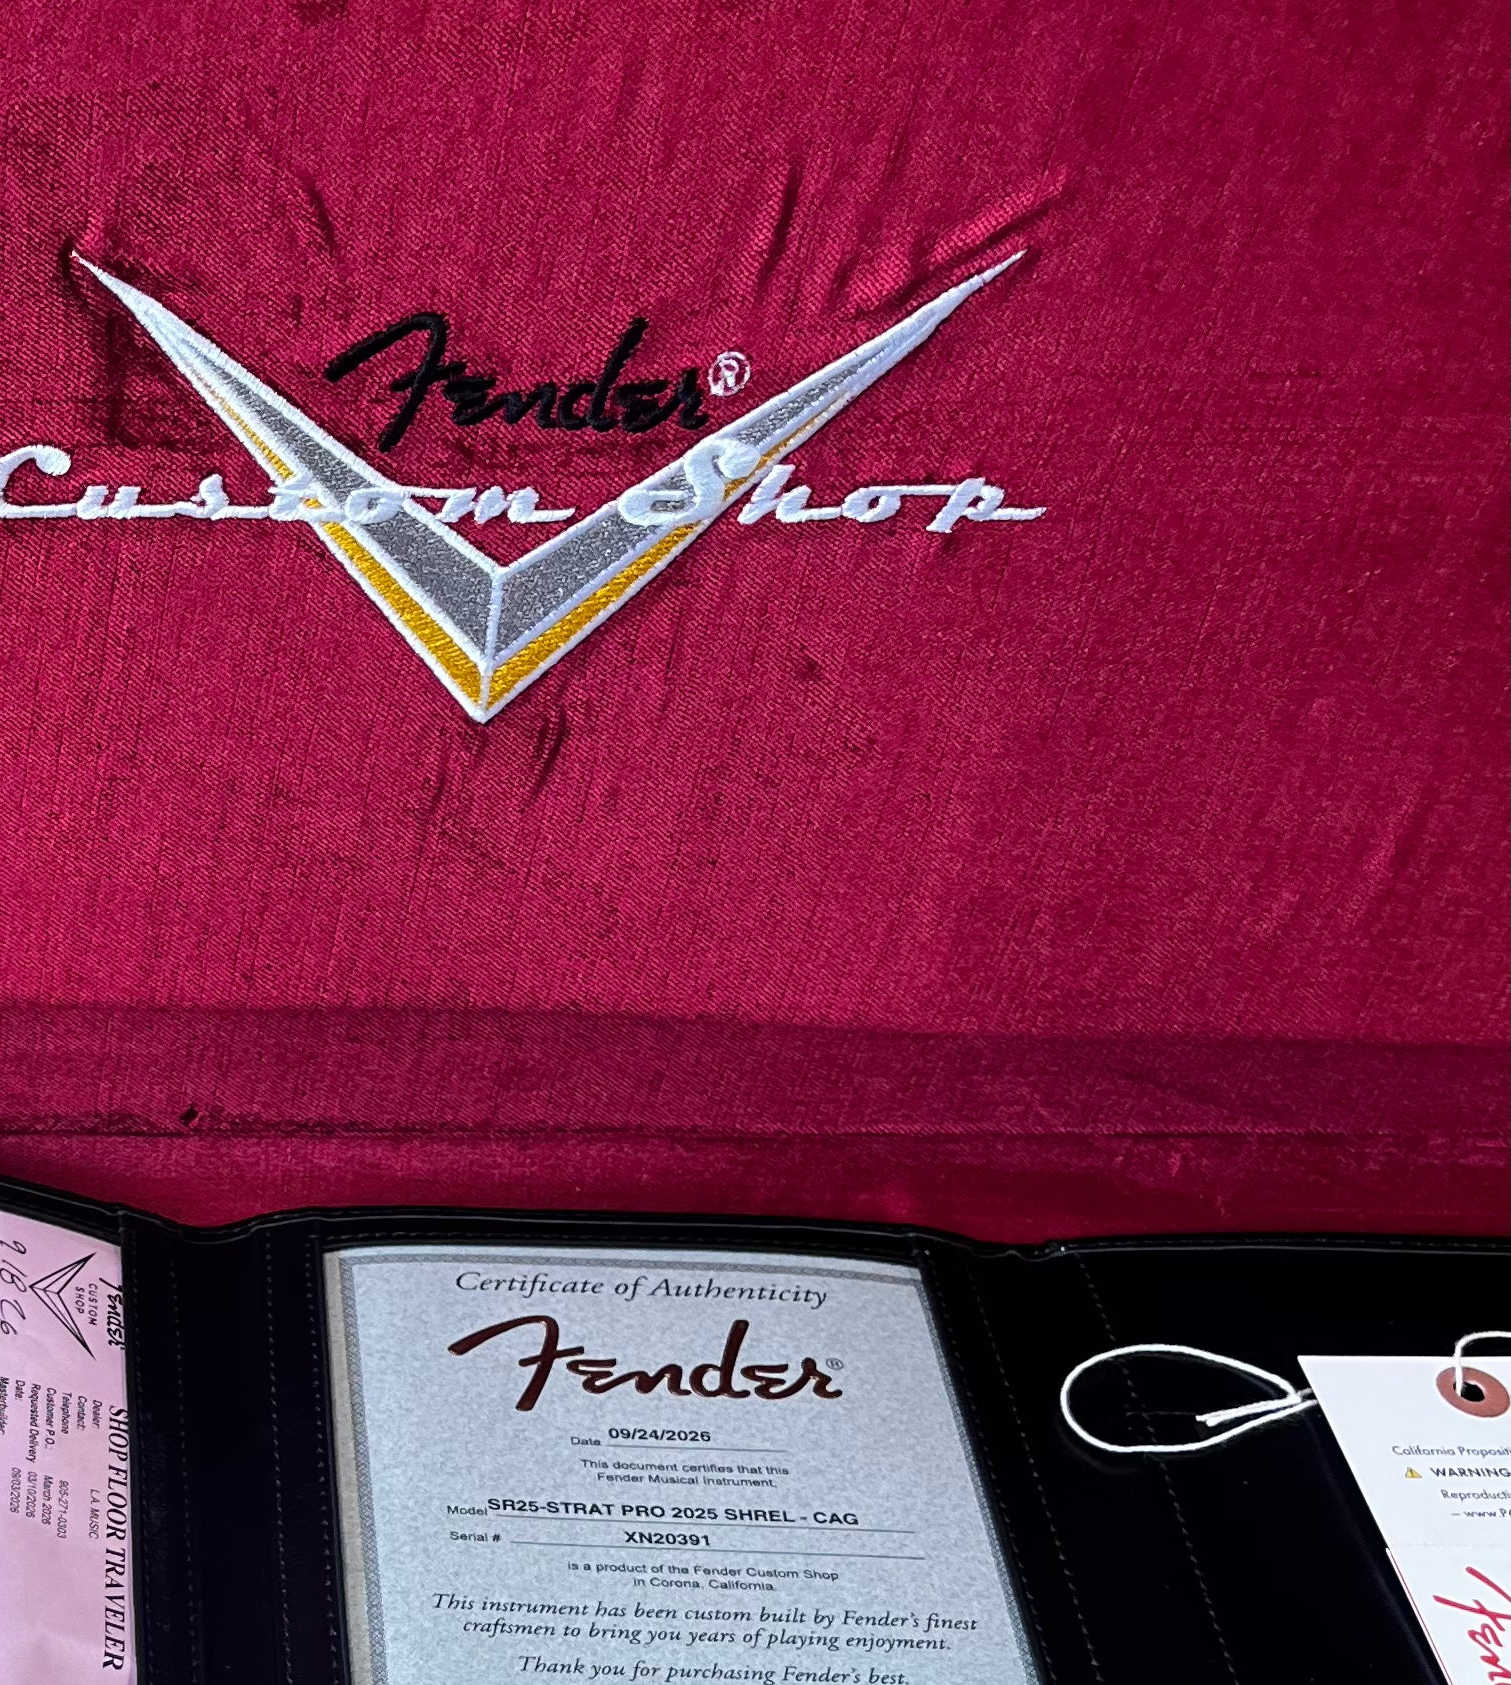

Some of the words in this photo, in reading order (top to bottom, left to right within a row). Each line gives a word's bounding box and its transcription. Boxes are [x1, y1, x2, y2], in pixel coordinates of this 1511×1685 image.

[617, 434, 1047, 533] Shop
[74, 1286, 85, 1313] SHOP
[87, 1282, 98, 1325] CUSTOM
[455, 1271, 603, 1298] Certificate
[614, 1275, 647, 1301] of
[649, 1277, 826, 1310] Authenticity
[107, 1404, 128, 1461] SHOP
[570, 1435, 601, 1446] Date
[607, 1427, 710, 1441] 09/24/2026
[1392, 1445, 1456, 1457] California
[579, 1458, 608, 1468] This
[612, 1461, 678, 1471] document
[681, 1463, 733, 1473] certifies
[736, 1464, 762, 1474] that
[765, 1465, 789, 1475] this
[596, 1471, 644, 1485] Fender
[647, 1474, 698, 1484] Musical
[42, 1474, 53, 1501] March
[41, 1502, 52, 1525] 2026
[105, 1463, 126, 1540] FLOOR
[446, 1504, 487, 1515] Model
[486, 1497, 614, 1515] SR25-STRAT
[621, 1504, 665, 1518] PRO
[670, 1506, 718, 1519] 2025
[723, 1508, 795, 1522] SHREL
[812, 1511, 858, 1525] CAG
[449, 1530, 488, 1541] Serial
[623, 1530, 710, 1546] XN20391
[567, 1561, 578, 1570] is
[595, 1562, 647, 1573] product
[650, 1563, 663, 1577] of
[667, 1564, 689, 1574] the
[693, 1563, 741, 1576] Fender
[745, 1567, 799, 1578] Custom
[802, 1569, 838, 1581] Shop
[633, 1576, 645, 1587] in
[102, 1547, 124, 1670] TRAVELER
[432, 1592, 474, 1610] This
[481, 1596, 588, 1618] instrument
[594, 1600, 626, 1617] has
[633, 1601, 676, 1619] been
[684, 1609, 751, 1621] custom
[759, 1605, 806, 1623] built
[813, 1608, 834, 1629] by
[926, 1612, 977, 1632] finest
[462, 1616, 555, 1638] craftsmen
[563, 1625, 580, 1637] to
[588, 1621, 642, 1644] bring
[646, 1630, 681, 1645] you
[688, 1631, 735, 1646] years
[742, 1627, 766, 1648] of
[767, 1628, 839, 1651] playing
[845, 1631, 950, 1653] enjoyment.
[518, 1655, 585, 1674] Thank
[590, 1664, 625, 1680] you
[632, 1660, 661, 1682] for
[666, 1662, 775, 1685] purchasing
[868, 1667, 908, 1685] best.
